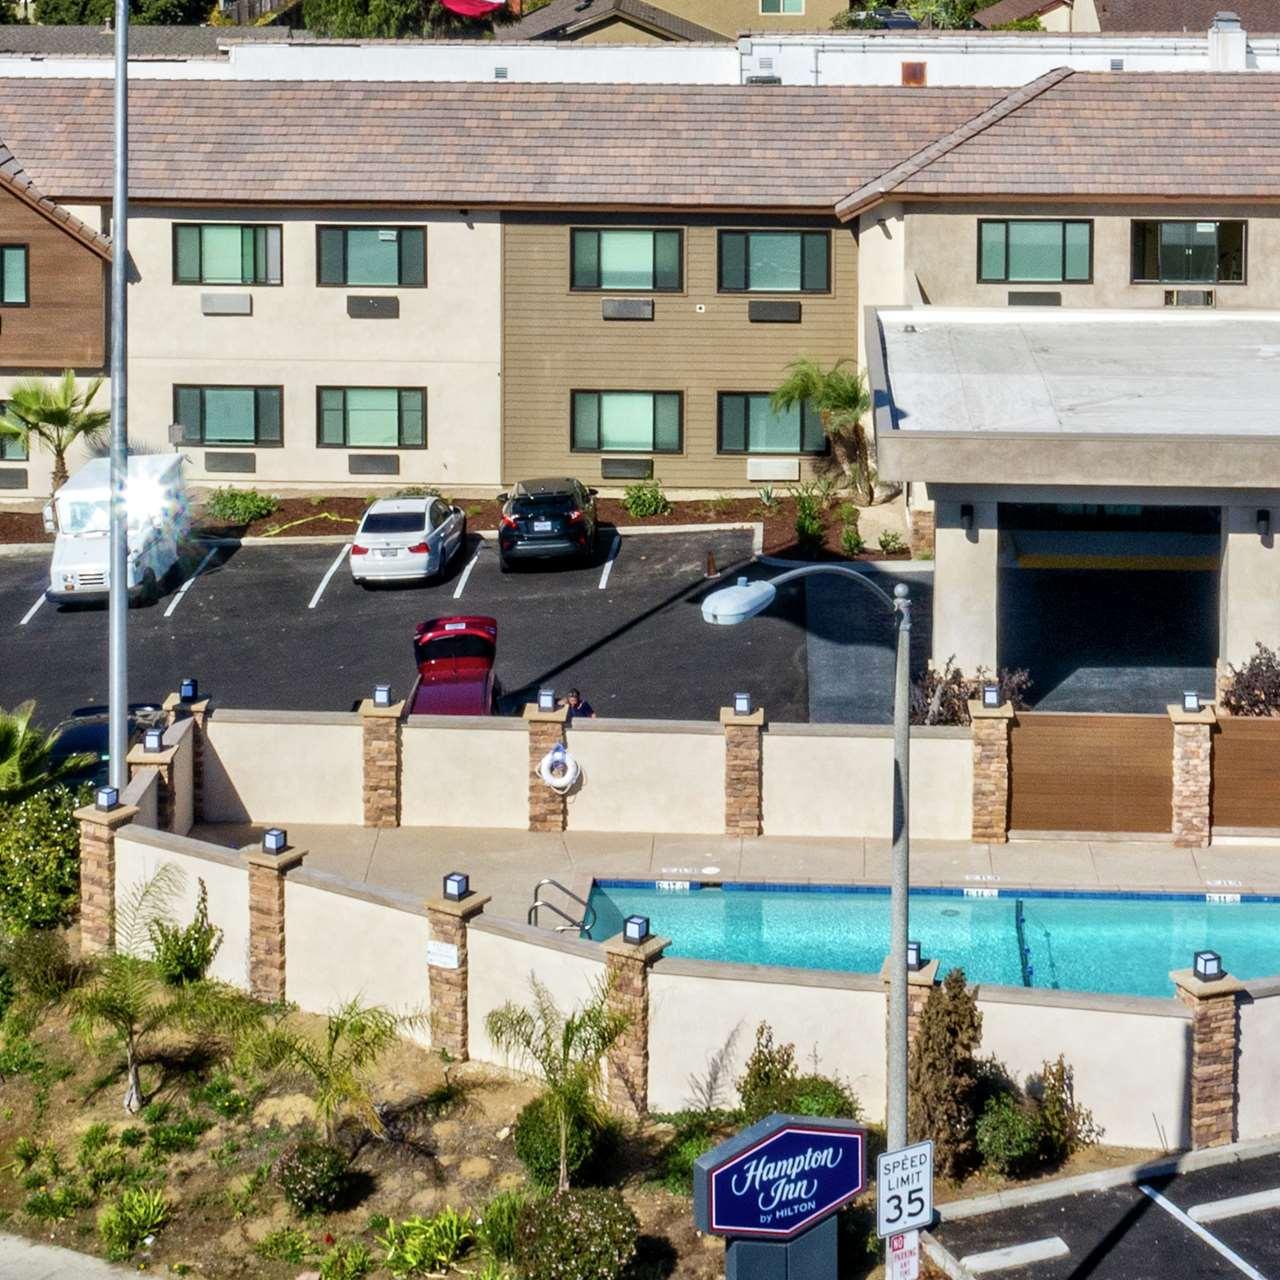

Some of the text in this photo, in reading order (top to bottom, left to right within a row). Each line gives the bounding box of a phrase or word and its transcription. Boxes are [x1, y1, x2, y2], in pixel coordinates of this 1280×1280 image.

[731, 1147, 843, 1196] Hampton
[883, 1153, 928, 1175] SPEED
[888, 1170, 922, 1191] LIMIT
[758, 1178, 818, 1211] Inn
[885, 1186, 925, 1223] 35
[775, 1201, 816, 1218] HILTON
[893, 1235, 903, 1250] NO
[894, 1246, 917, 1262] PARKING
